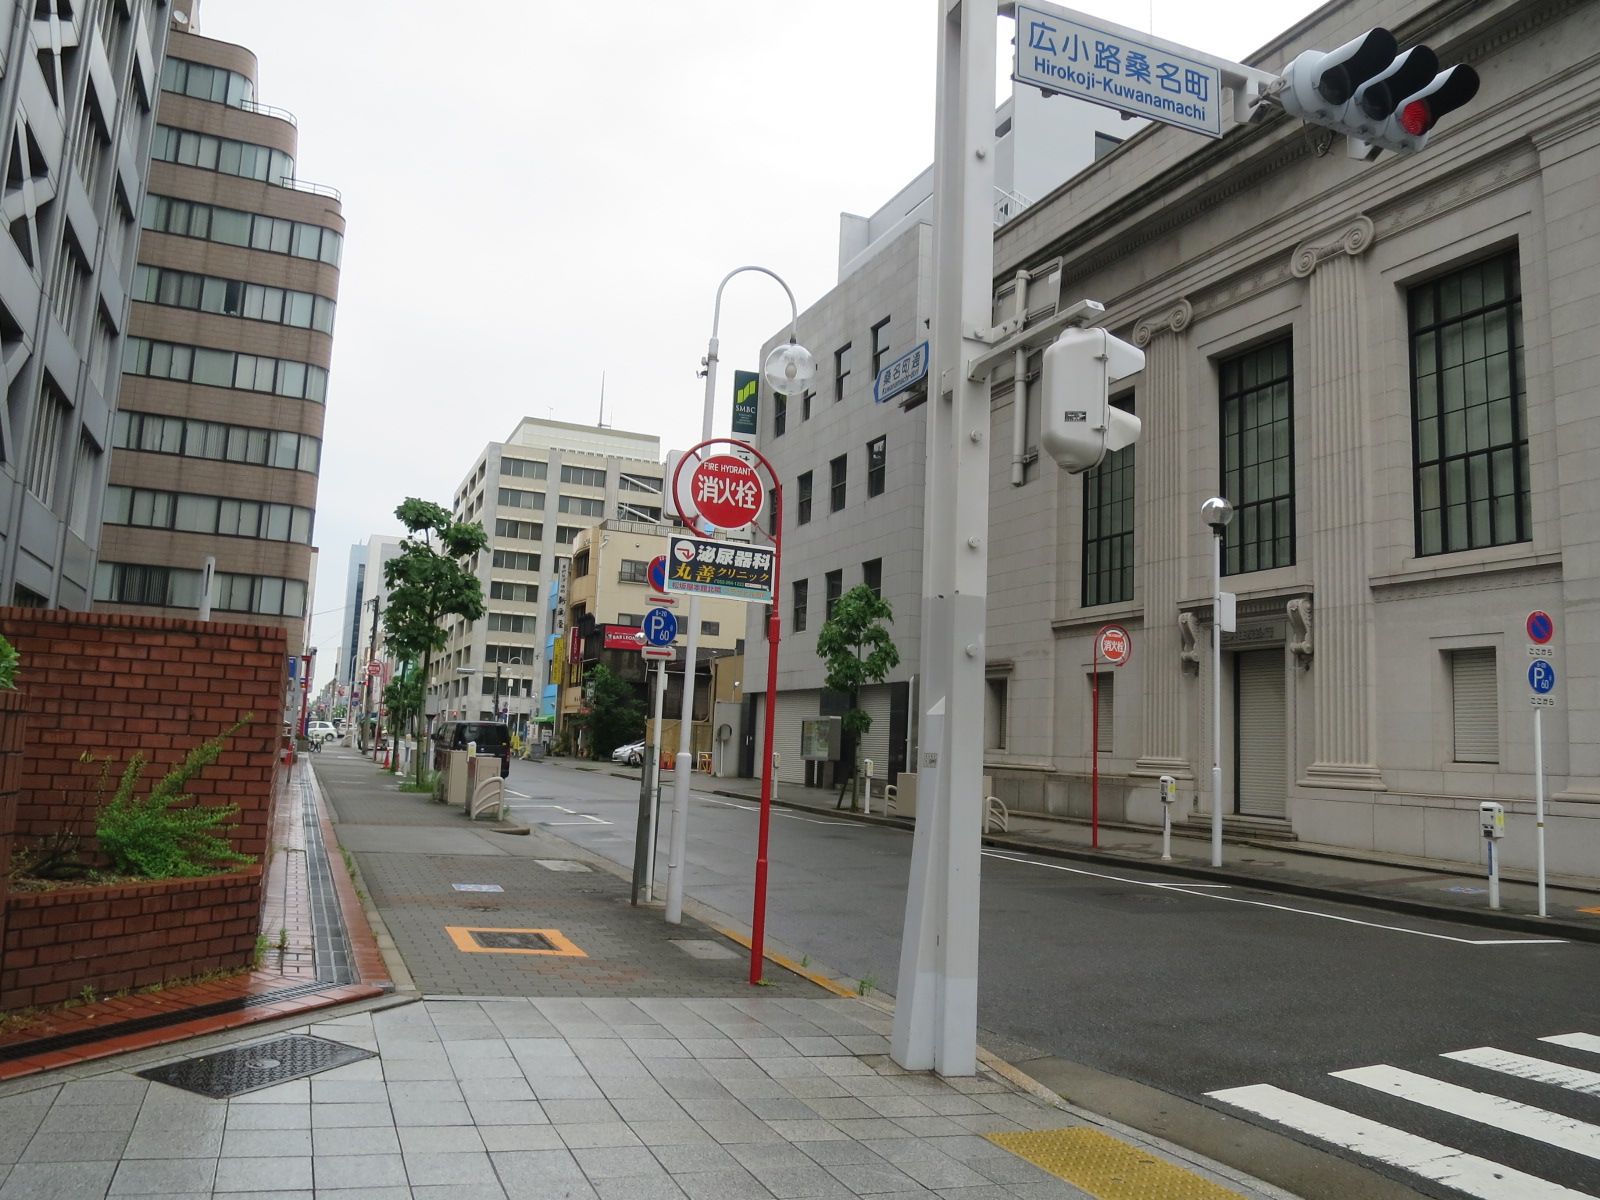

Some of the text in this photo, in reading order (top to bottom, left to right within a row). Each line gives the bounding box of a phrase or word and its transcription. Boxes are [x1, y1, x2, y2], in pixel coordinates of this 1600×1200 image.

[1029, 22, 1209, 102] 広小路桑名町
[1034, 56, 1206, 121] Hirokoji-Kuwanamachi
[735, 404, 756, 414] SMBC
[703, 462, 752, 476] FIRE HYDRANT
[697, 474, 758, 509] 消火栓
[696, 544, 771, 571] 泌尿器科
[651, 616, 664, 639] P
[1103, 640, 1124, 652] 消火栓
[1534, 667, 1544, 688] P
